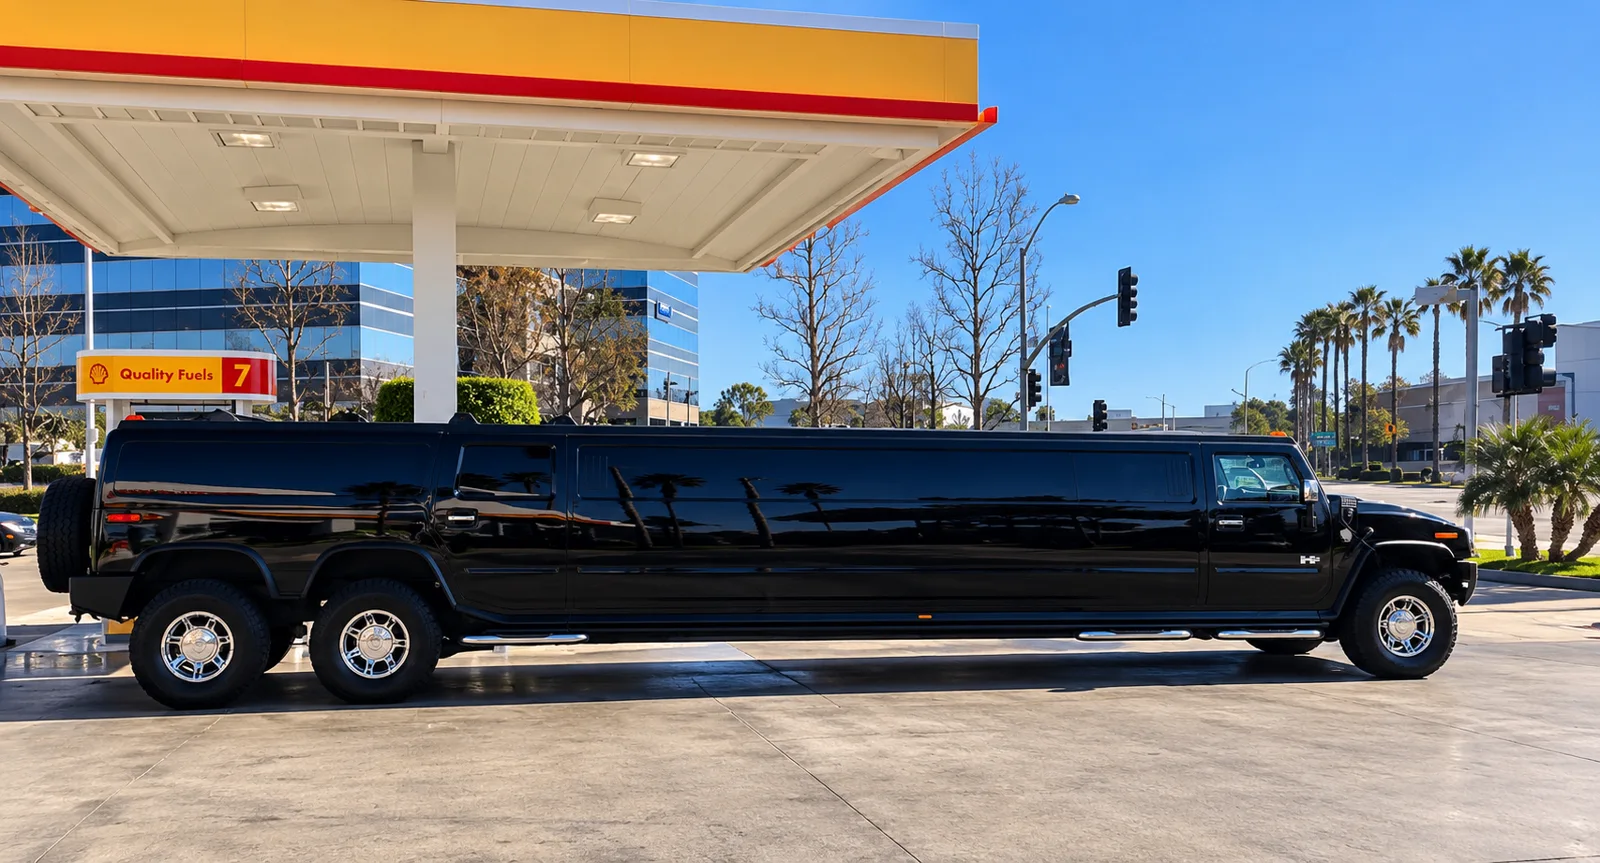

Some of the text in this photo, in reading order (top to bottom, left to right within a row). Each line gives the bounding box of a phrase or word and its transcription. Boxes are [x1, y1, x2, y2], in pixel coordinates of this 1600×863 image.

[120, 368, 213, 383] Quality Fuels
[234, 364, 251, 387] 7
